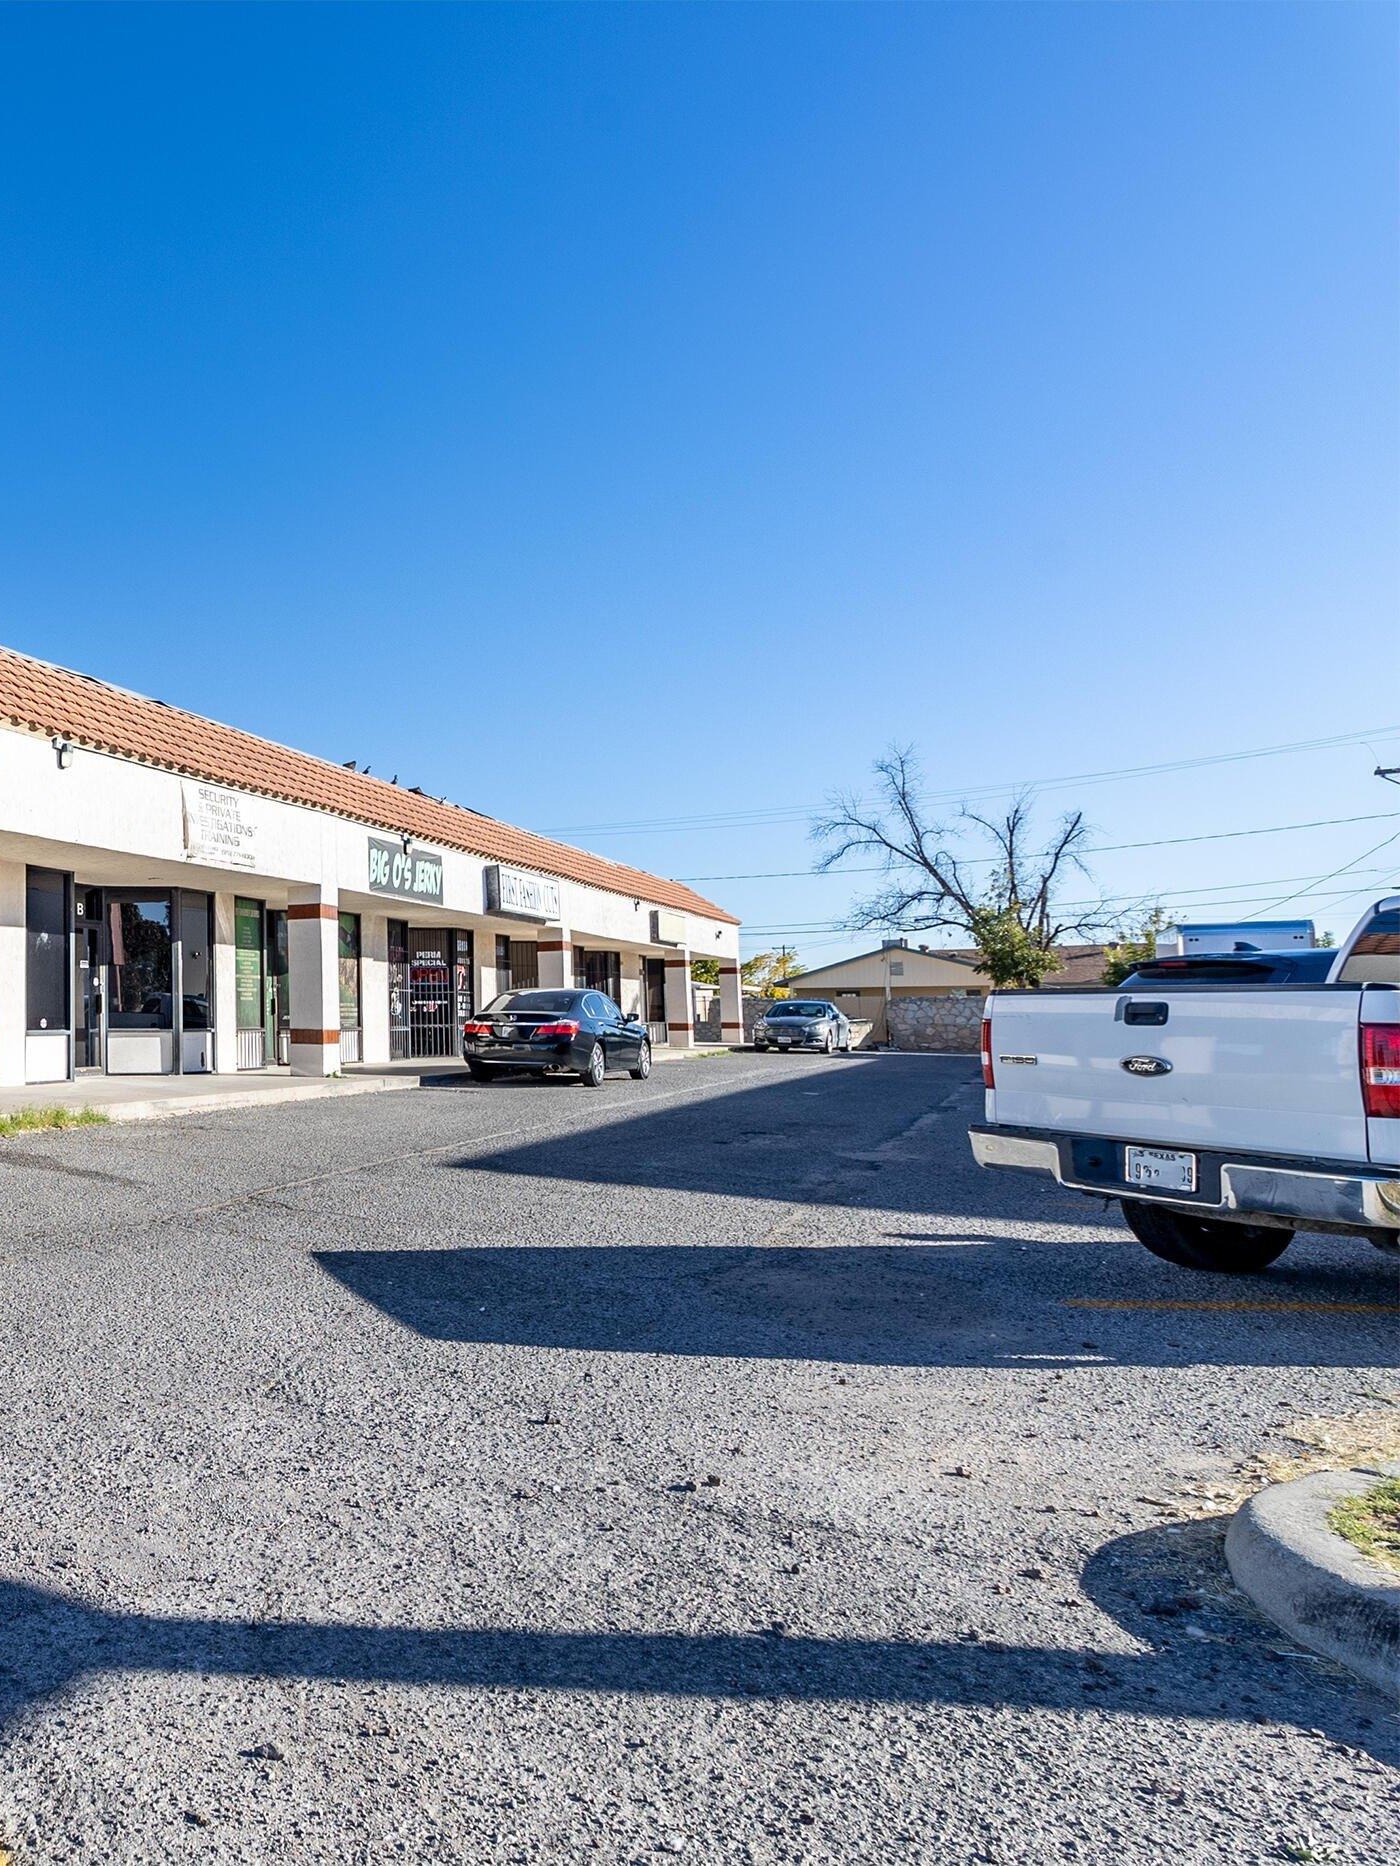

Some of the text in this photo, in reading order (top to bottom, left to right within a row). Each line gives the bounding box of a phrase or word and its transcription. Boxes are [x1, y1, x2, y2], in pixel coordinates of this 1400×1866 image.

[198, 788, 239, 808] SECURITY
[206, 803, 241, 822] PRIVATE
[369, 848, 389, 886] BIG
[413, 860, 442, 895] JERKY
[76, 903, 84, 915] B
[416, 951, 441, 959] PERM
[1128, 1057, 1156, 1072] Ford
